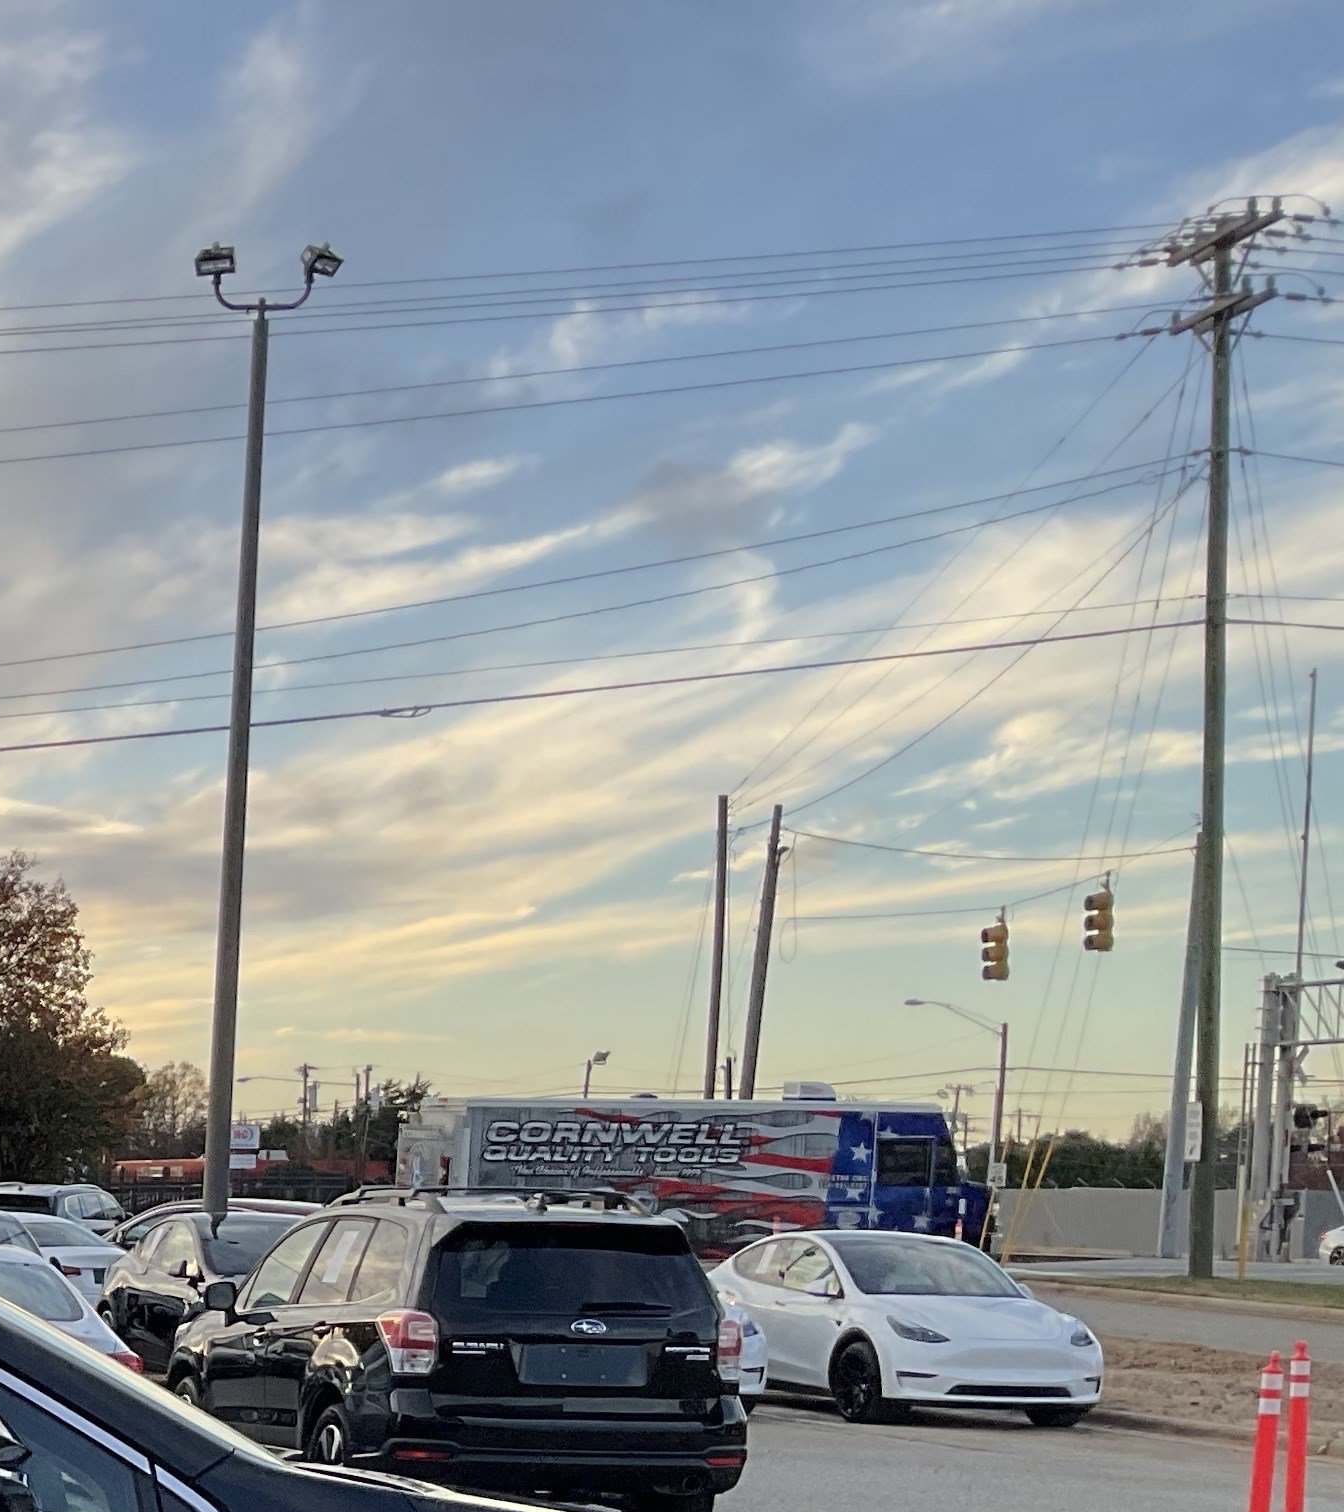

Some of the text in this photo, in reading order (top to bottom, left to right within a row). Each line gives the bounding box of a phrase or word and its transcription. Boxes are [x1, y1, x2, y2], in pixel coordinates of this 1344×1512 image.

[486, 1120, 743, 1146] CORNWELL
[482, 1145, 741, 1164] QUALITY TOOLS
